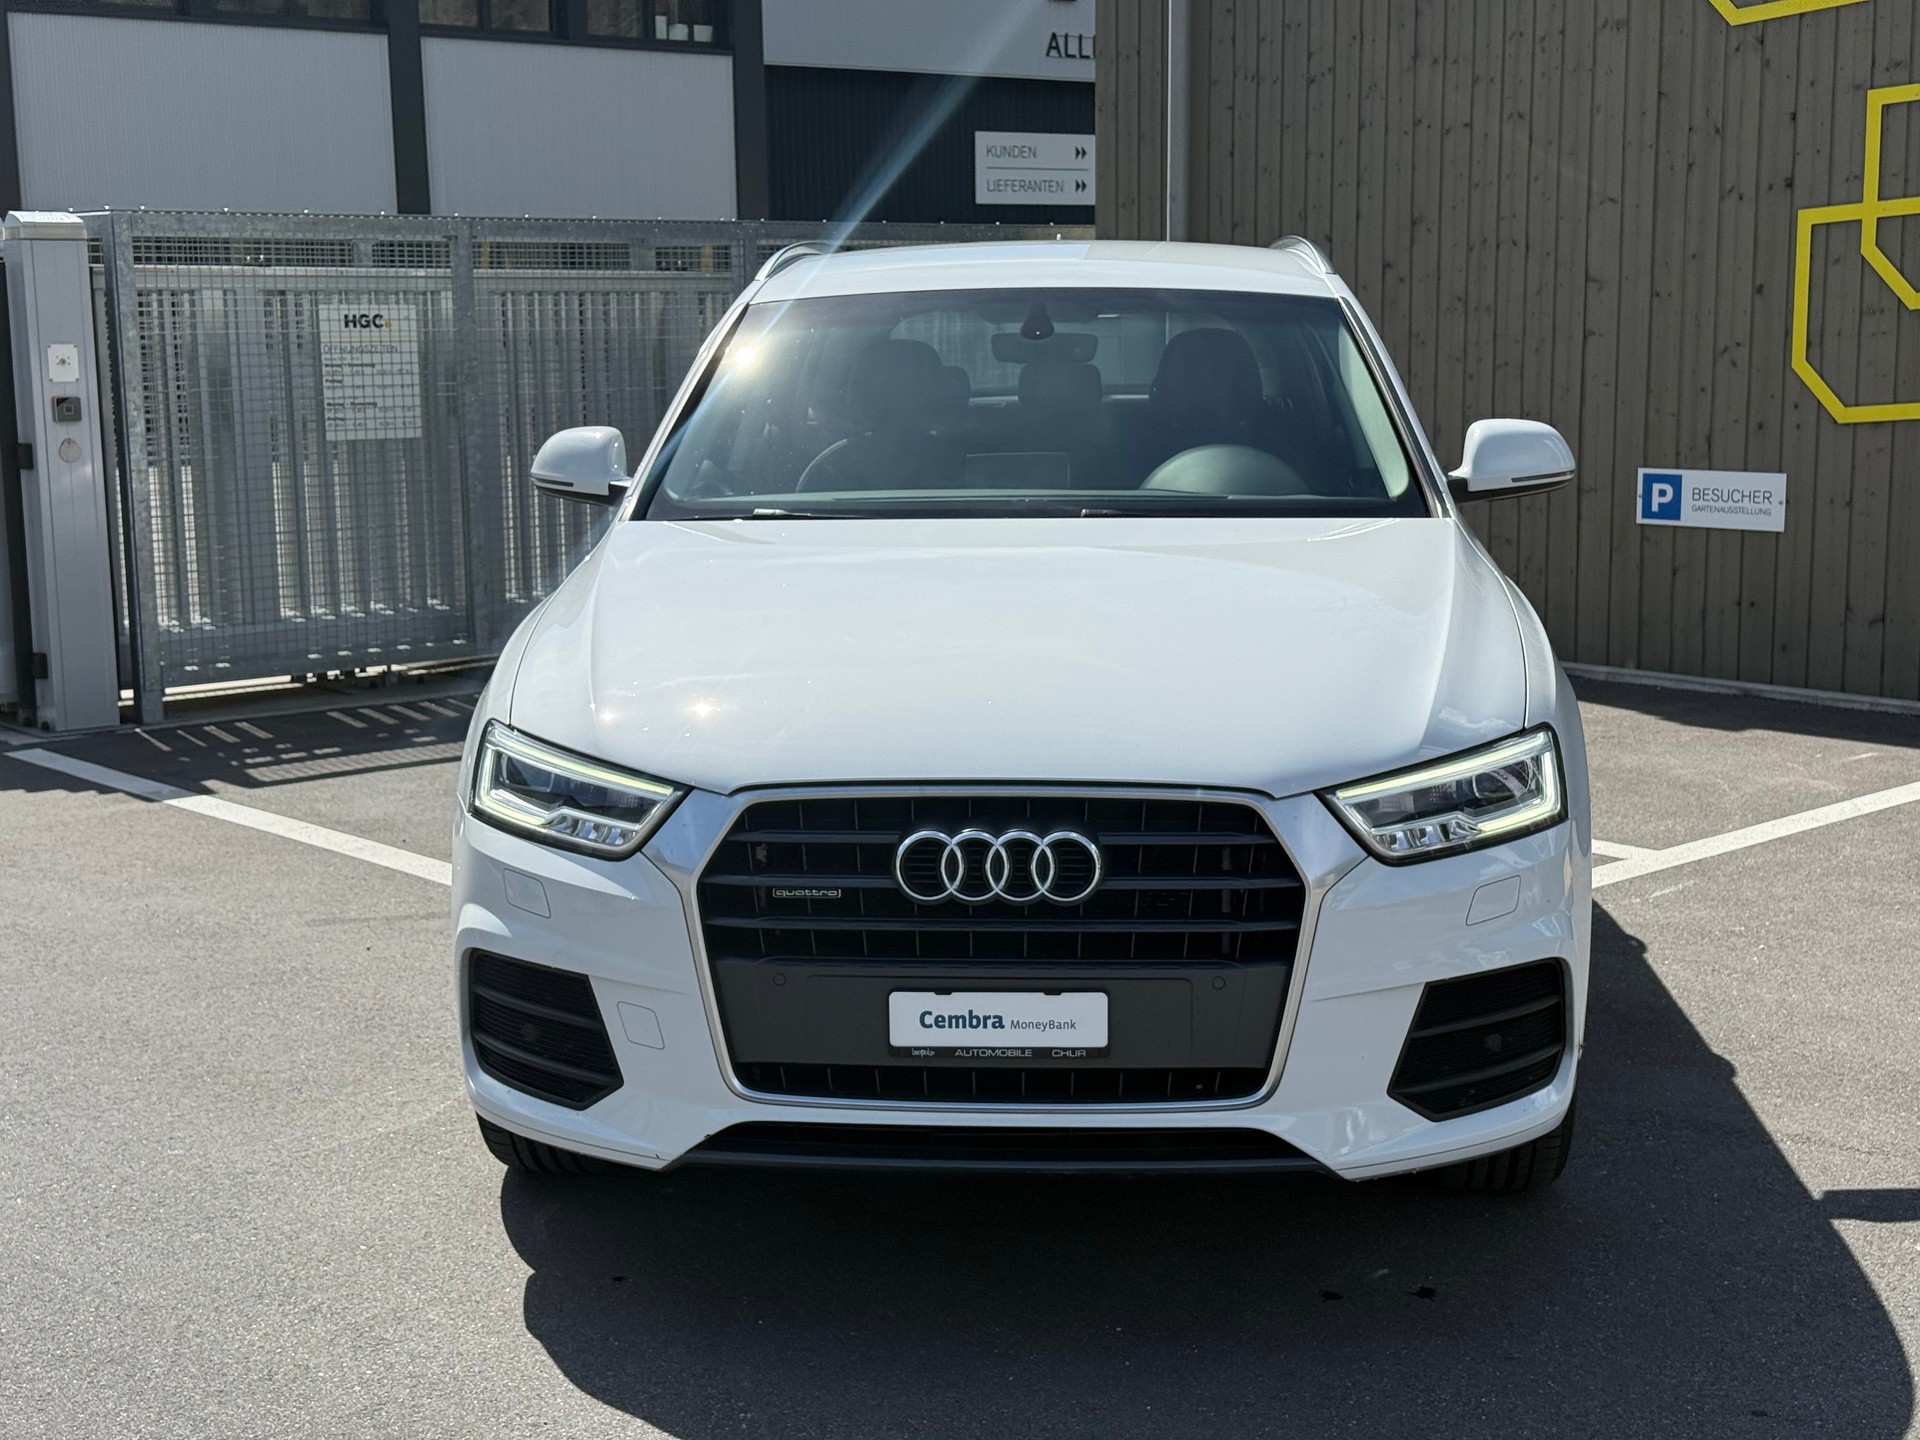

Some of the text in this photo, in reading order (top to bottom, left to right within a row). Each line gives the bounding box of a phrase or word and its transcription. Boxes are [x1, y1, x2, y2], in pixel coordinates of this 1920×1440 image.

[1045, 31, 1096, 60] ALL
[985, 145, 1037, 159] KUNDEN
[986, 178, 1065, 193] LIEFERANTEN
[343, 313, 384, 329] HGC
[1651, 483, 1674, 513] P
[1691, 487, 1773, 505] BESUCHER
[1691, 504, 1772, 517] GARTENAUSSTELLUNG
[775, 888, 838, 897] quattro
[919, 1009, 1077, 1032] Cembra MoneyBank
[954, 1048, 1087, 1058] AUTOMOBILE CHUR
